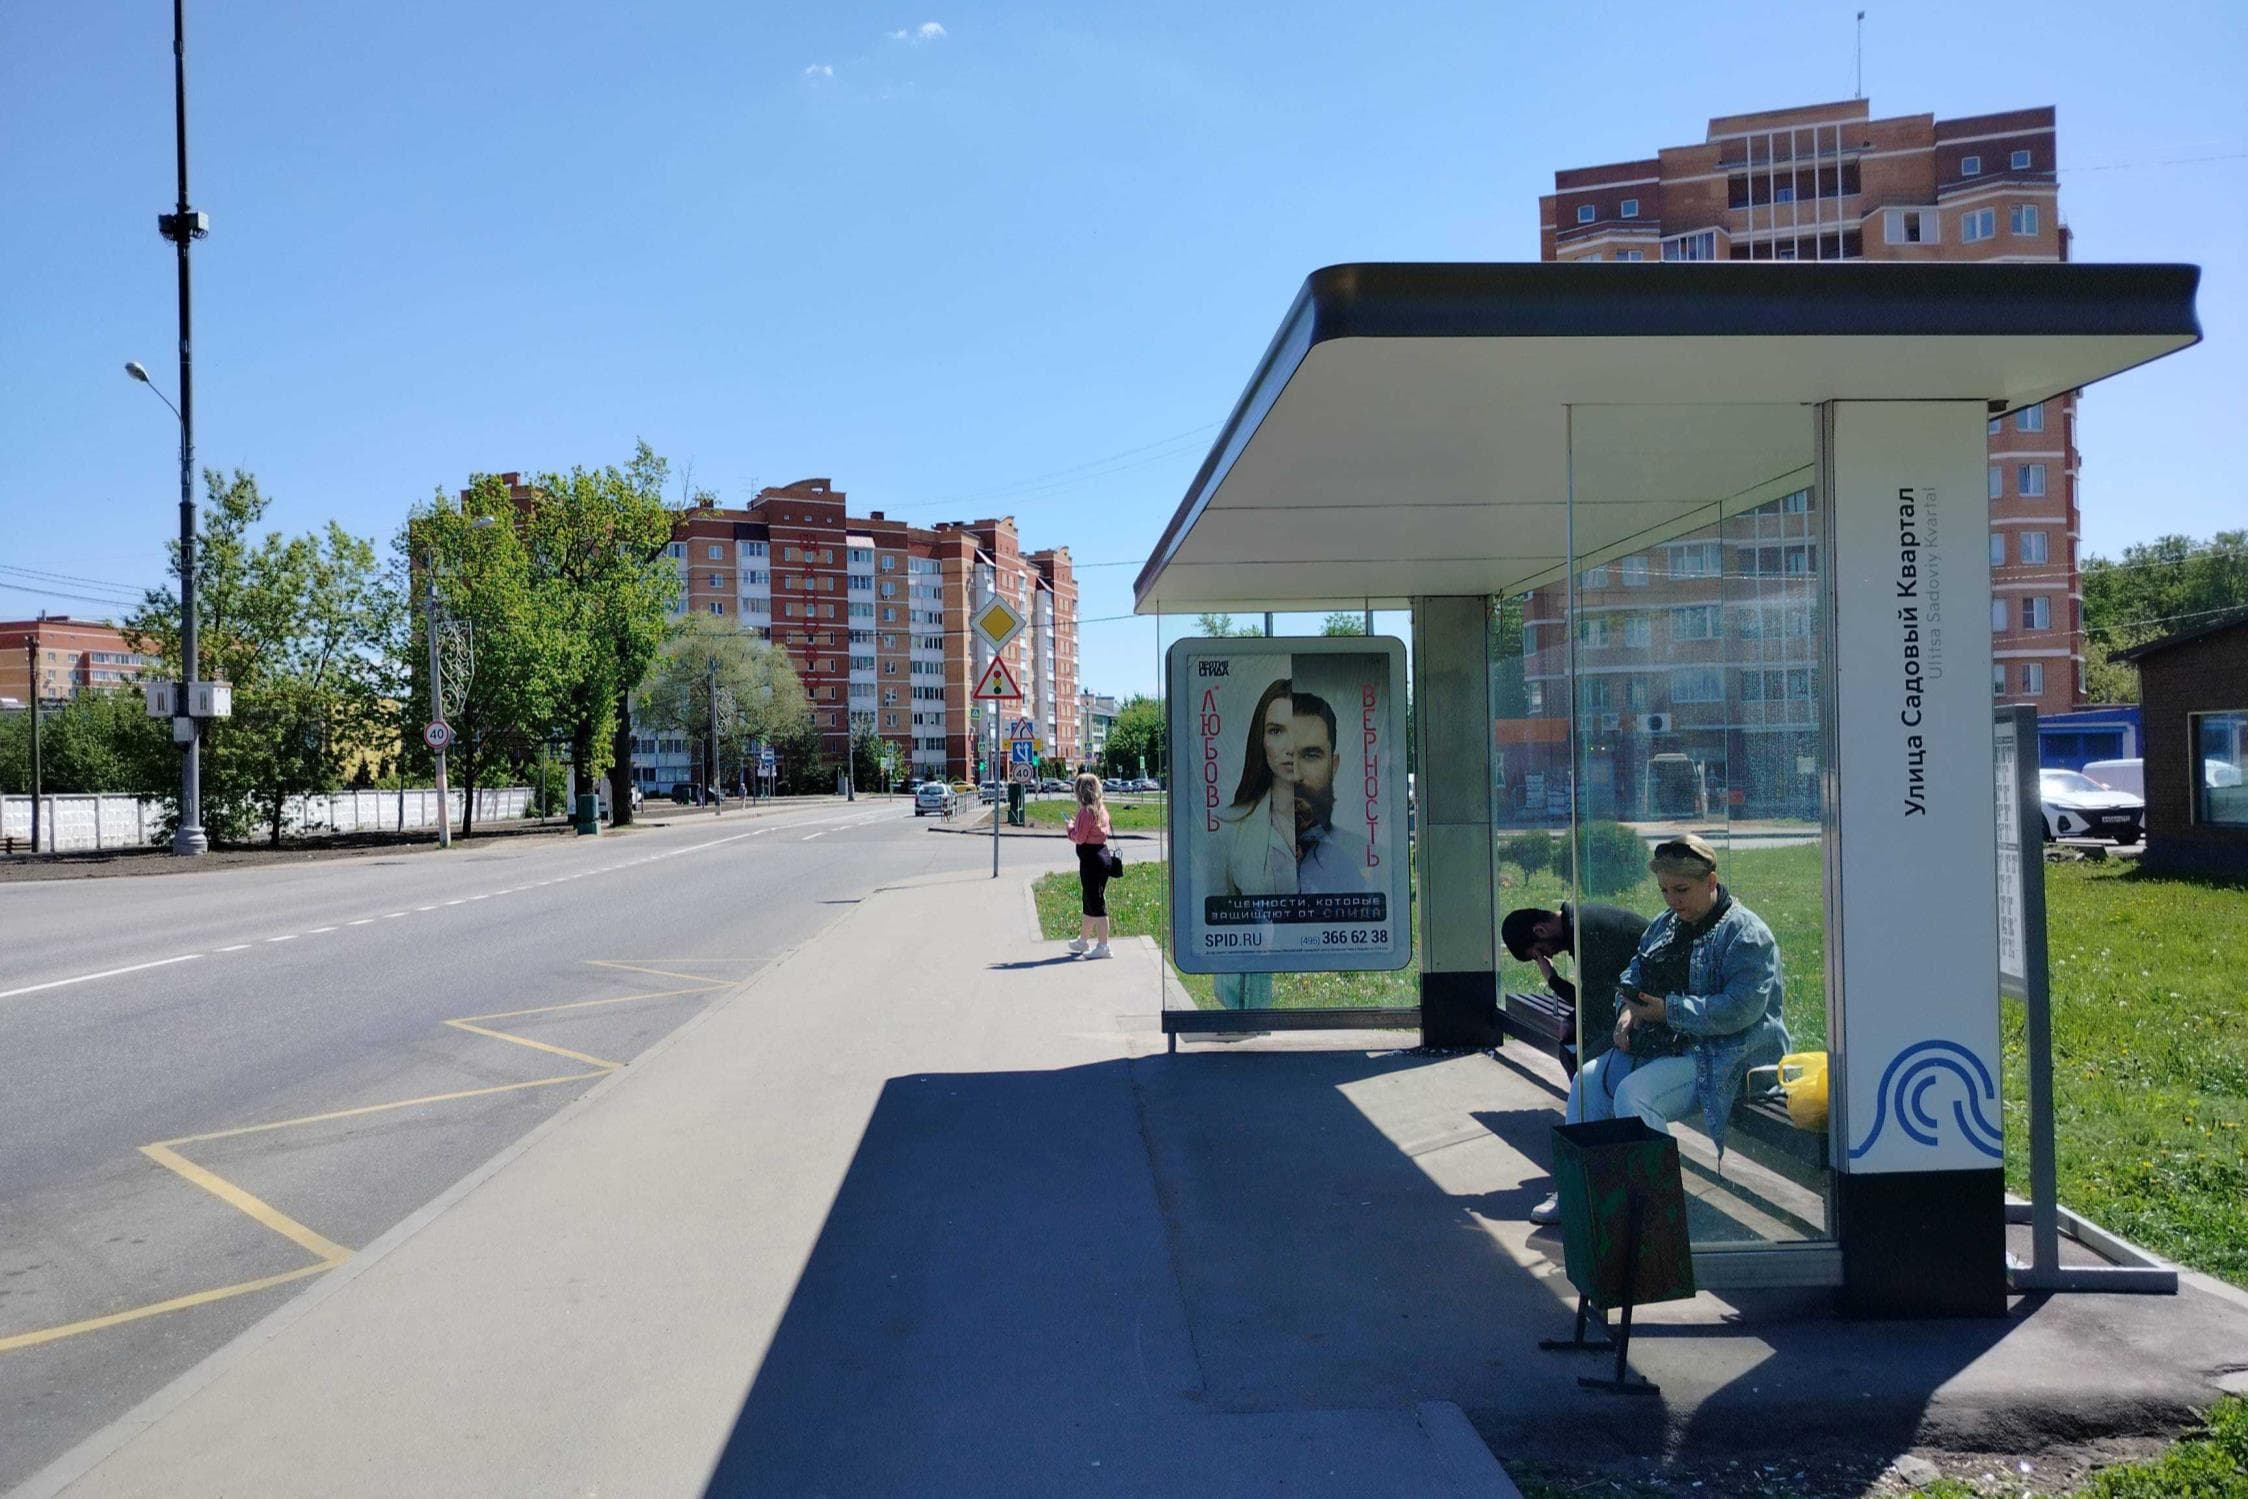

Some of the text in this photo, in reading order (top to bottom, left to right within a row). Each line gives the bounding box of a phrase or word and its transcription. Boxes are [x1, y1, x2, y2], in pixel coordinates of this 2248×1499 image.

[1922, 487, 1943, 680] Ulitsa Sadoviy Kvartal
[1897, 488, 1926, 816] Улица Садовый Квартал
[430, 729, 444, 739] 40
[1016, 768, 1029, 777] 40
[1362, 684, 1380, 867] ВЕРНОСТЬ
[1205, 933, 1262, 947] SPID.RU
[1322, 931, 1347, 944] 366
[1351, 930, 1367, 943] 62
[1371, 930, 1388, 943] 38
